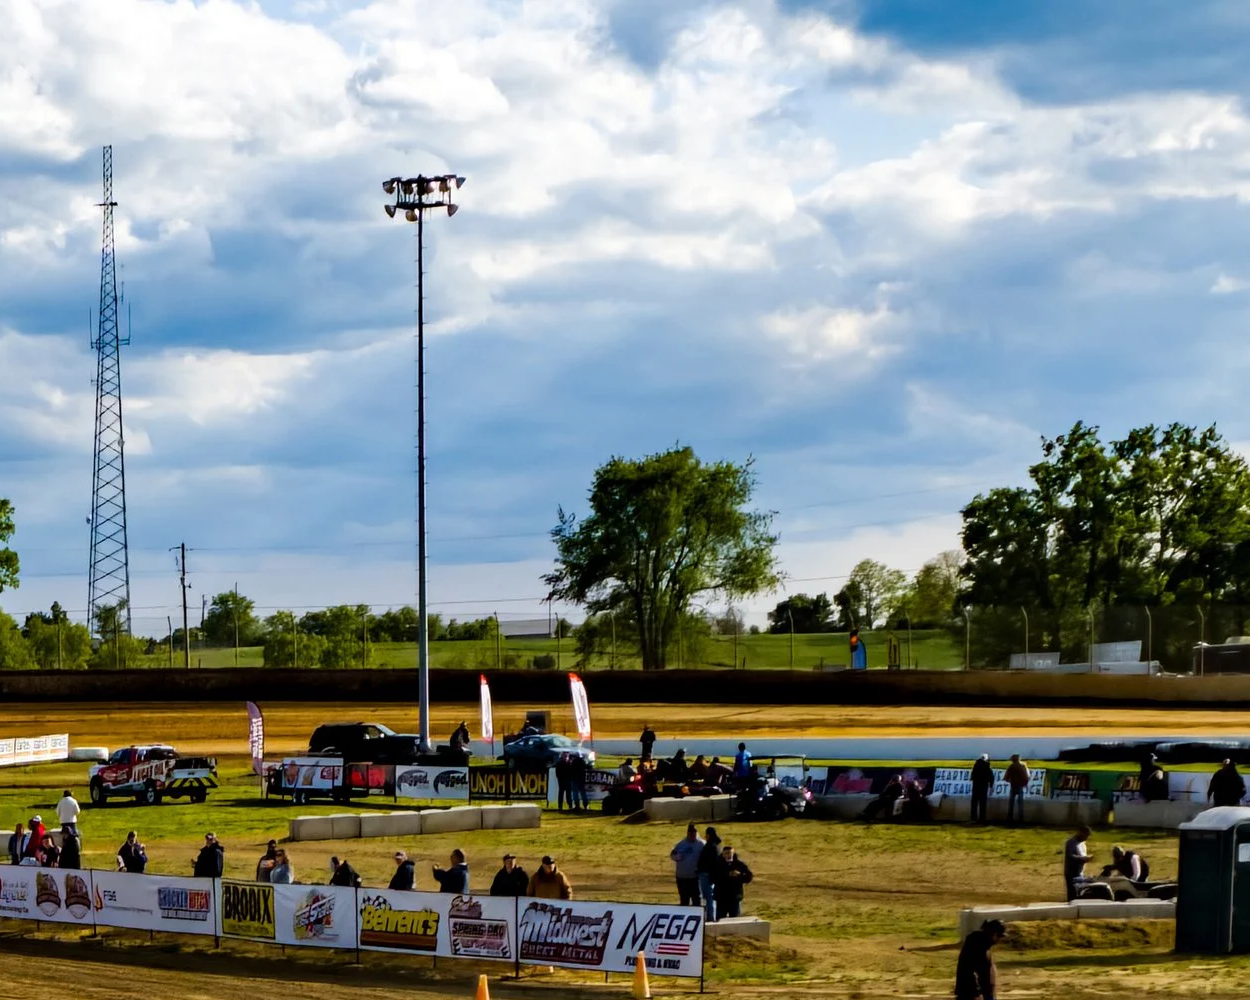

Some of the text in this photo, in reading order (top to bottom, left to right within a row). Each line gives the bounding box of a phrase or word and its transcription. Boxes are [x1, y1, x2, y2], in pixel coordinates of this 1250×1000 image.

[470, 773, 505, 793] UNOH
[510, 773, 546, 793] UNOH
[225, 886, 272, 925] BRODIX
[520, 904, 613, 947] Midwest
[616, 912, 701, 952] MEGA
[561, 947, 599, 960] METAL
